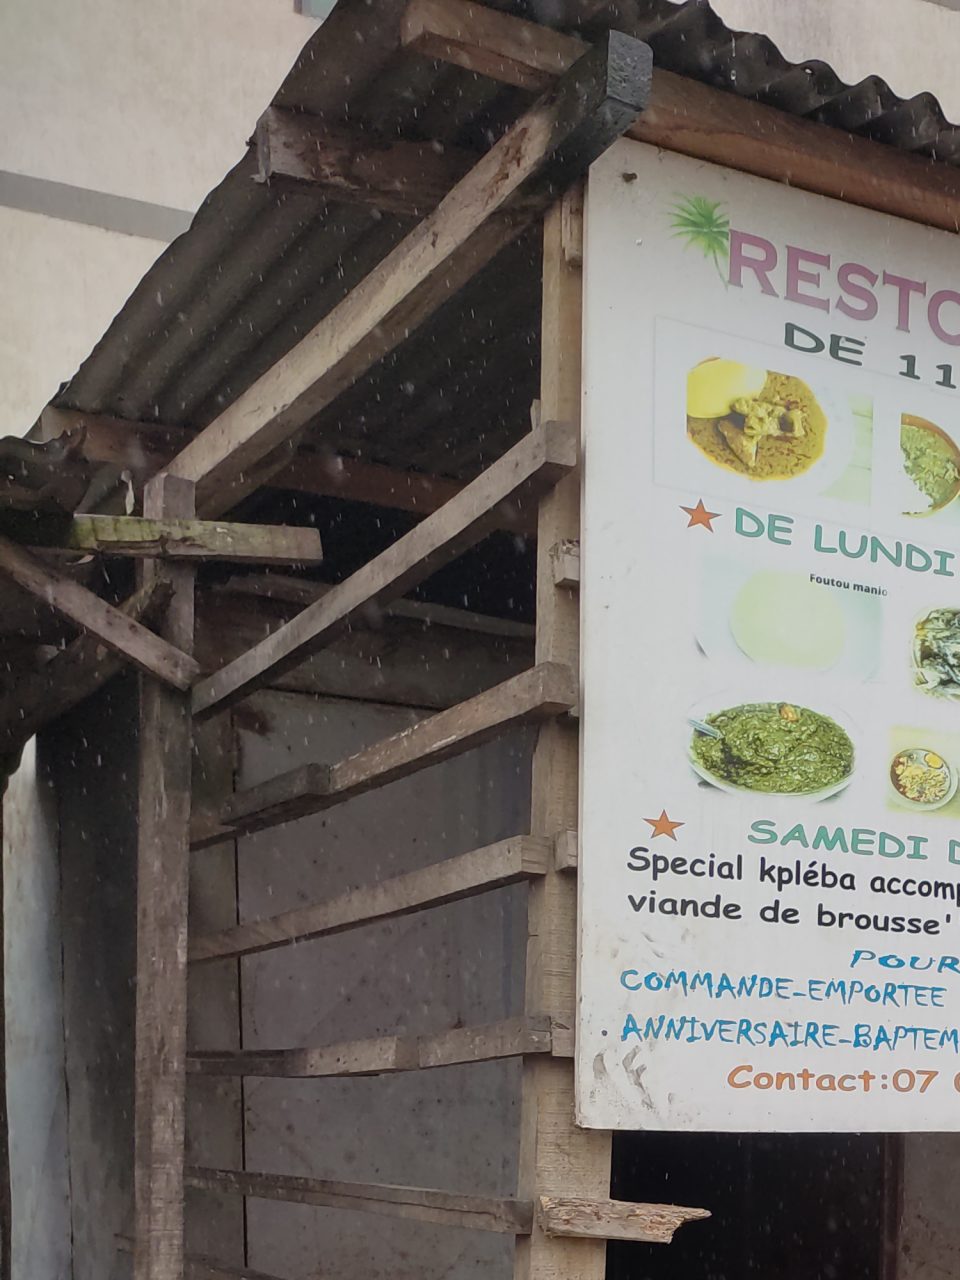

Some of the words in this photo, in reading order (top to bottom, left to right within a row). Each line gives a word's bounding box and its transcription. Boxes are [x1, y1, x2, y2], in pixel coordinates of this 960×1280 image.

[784, 322, 866, 366] DE
[735, 507, 794, 545] DE
[814, 524, 955, 577] LUNDI
[809, 573, 850, 589] Foutou
[747, 819, 928, 860] SAMEDI
[627, 846, 743, 881] Special
[759, 856, 856, 892] kpléba
[627, 890, 742, 920] viande
[759, 899, 800, 924] de
